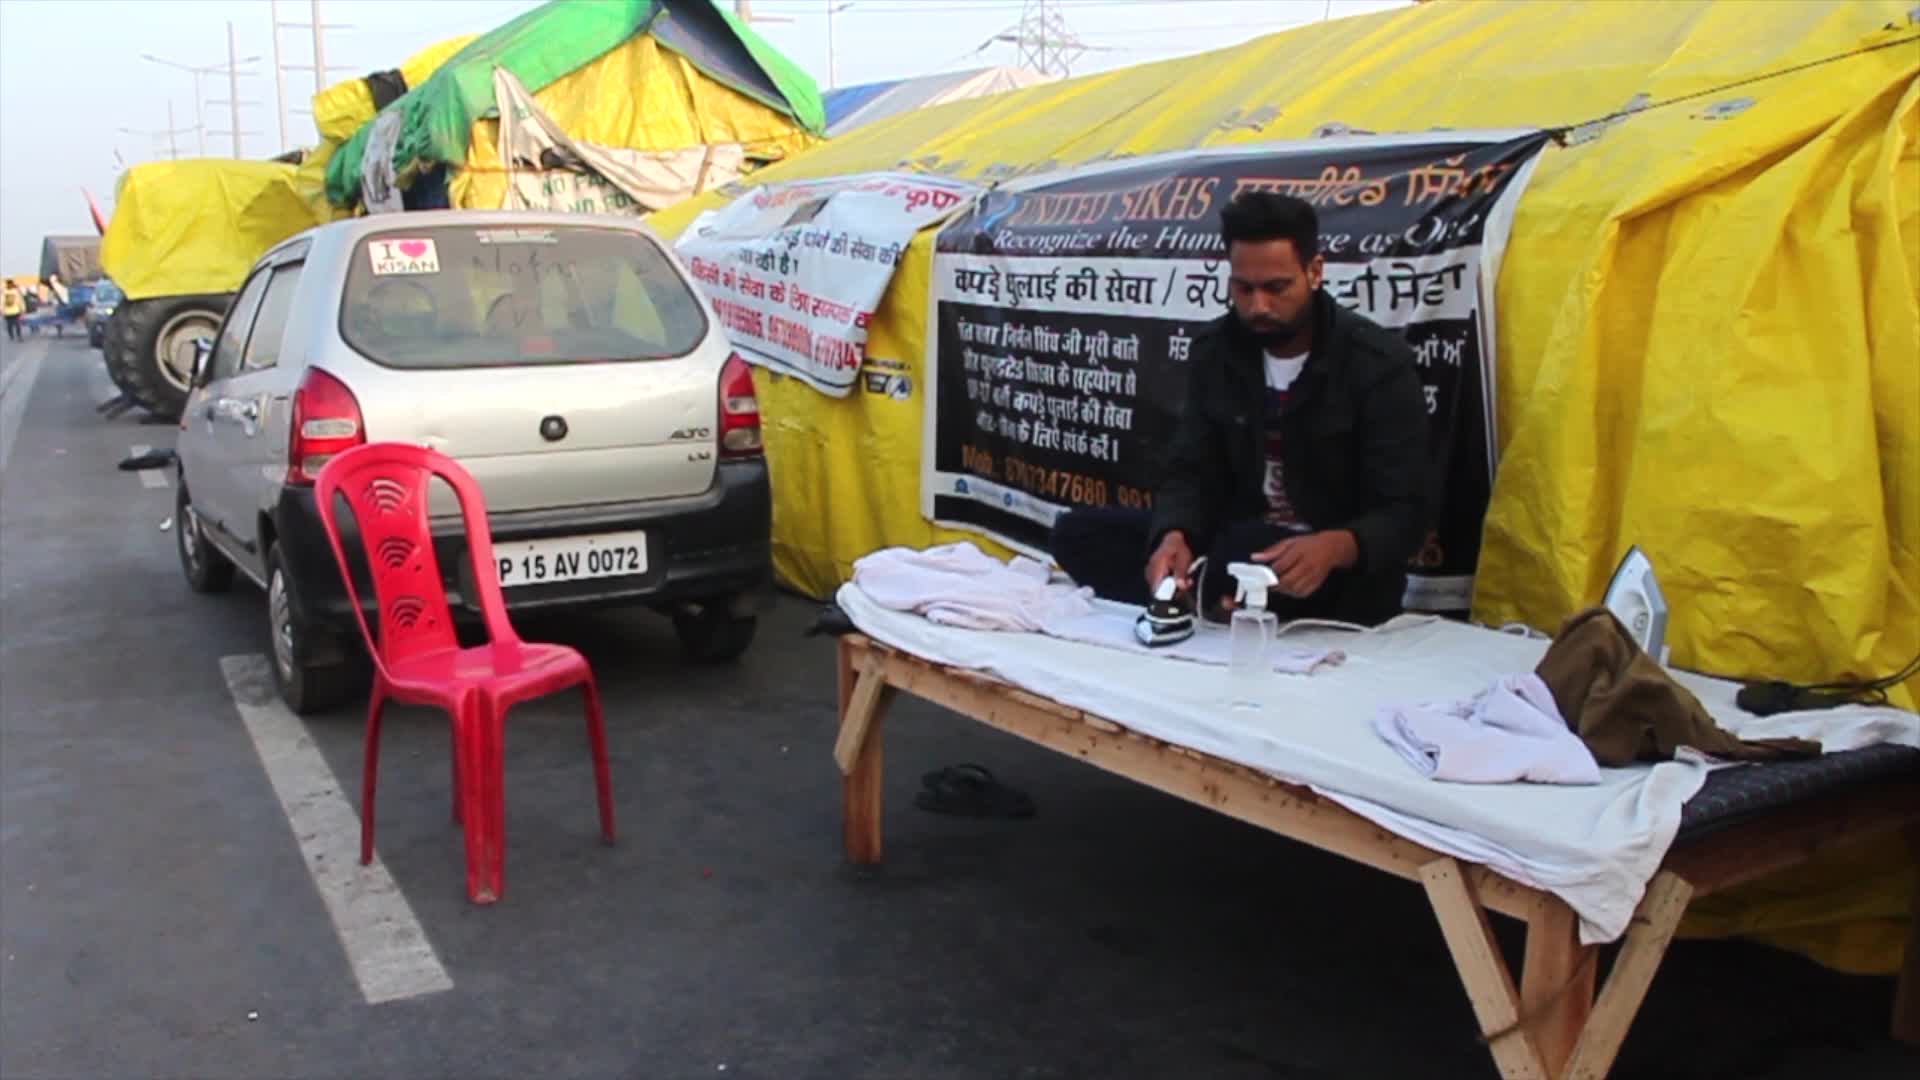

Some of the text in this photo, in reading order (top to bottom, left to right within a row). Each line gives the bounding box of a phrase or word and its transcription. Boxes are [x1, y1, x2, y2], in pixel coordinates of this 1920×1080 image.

[1008, 177, 1221, 225] UNITED SIKHS
[380, 243, 396, 260] I
[831, 231, 849, 257] की
[850, 236, 878, 263] सेवा
[994, 228, 1101, 254] Recognize
[1107, 226, 1148, 249] the
[376, 260, 435, 274] KISAN
[739, 272, 765, 300] सेवा
[769, 279, 786, 304] के
[1065, 267, 1100, 301] की
[1104, 268, 1157, 304] सेवा
[1062, 328, 1083, 355] जी
[1072, 365, 1122, 396] सहयोग
[1013, 389, 1045, 420] कपड़े
[1080, 397, 1100, 425] की
[1102, 401, 1133, 430] सेवा
[498, 546, 639, 582] P 15 AV 0072
